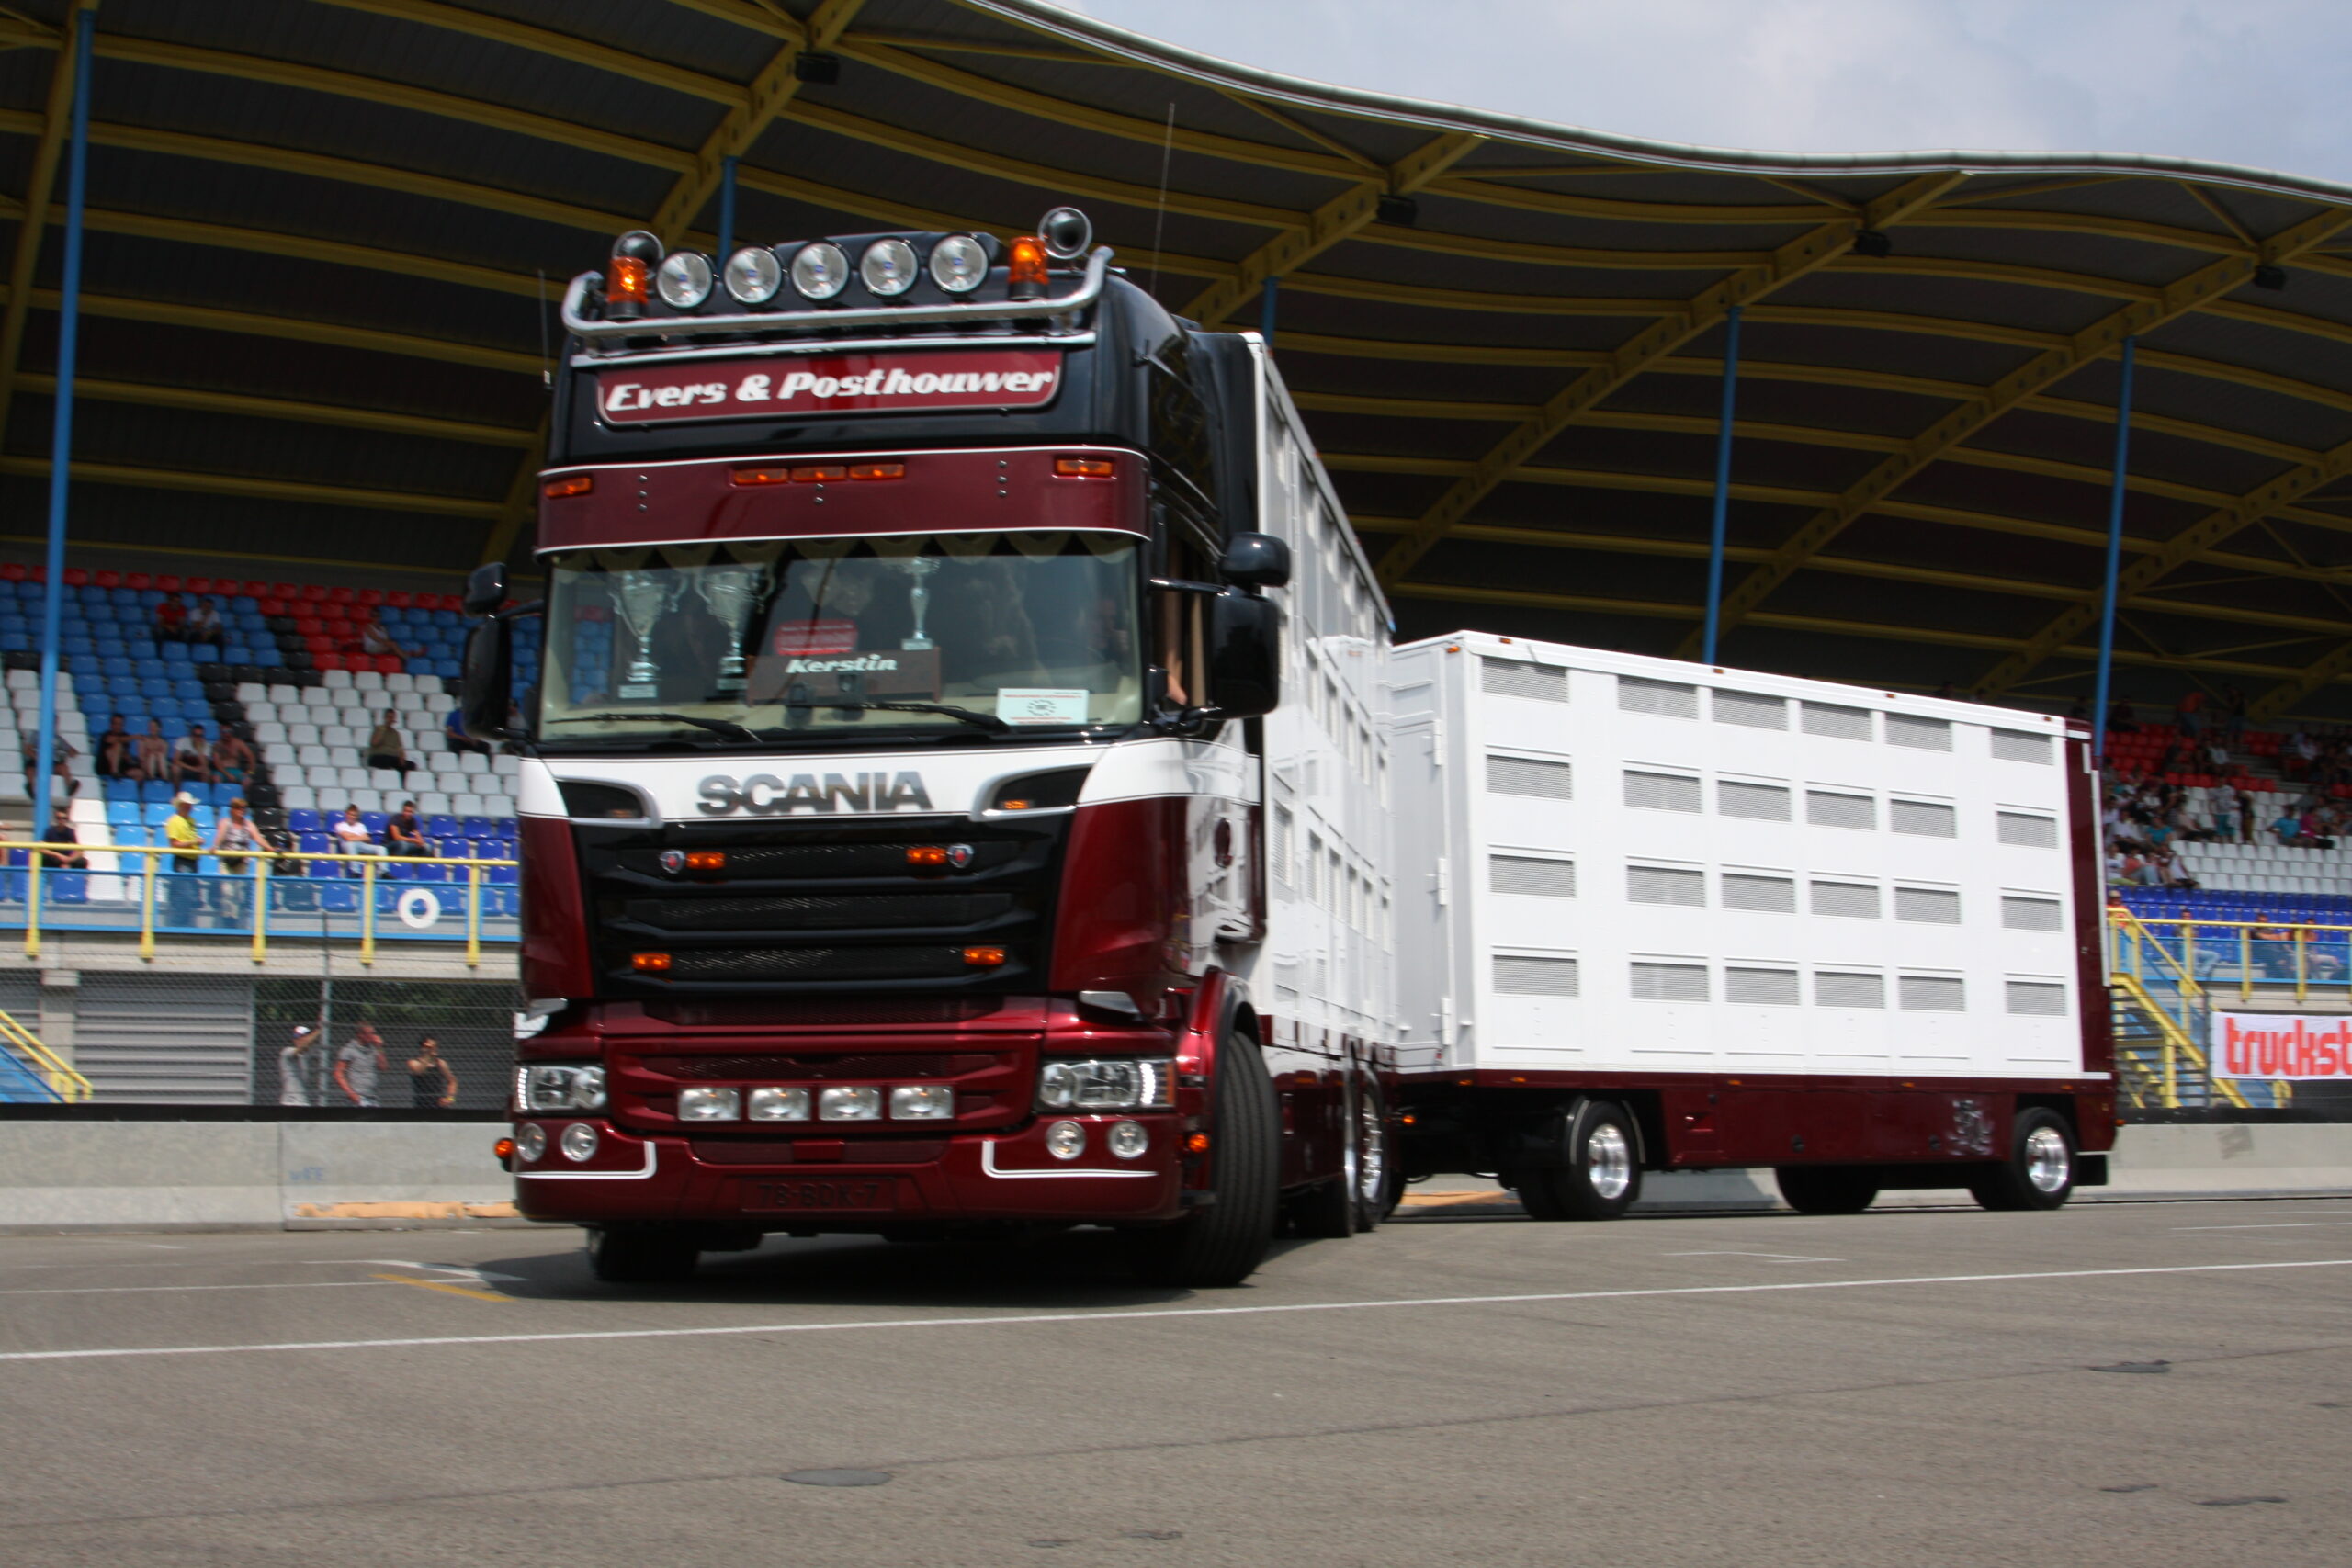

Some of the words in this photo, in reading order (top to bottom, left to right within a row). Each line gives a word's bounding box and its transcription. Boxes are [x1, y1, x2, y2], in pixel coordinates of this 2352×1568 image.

[605, 382, 728, 412] Evers
[735, 374, 772, 401] &
[776, 368, 1054, 400] Posthouwer
[785, 653, 898, 673] Kerstin
[696, 771, 933, 816] SCANIA
